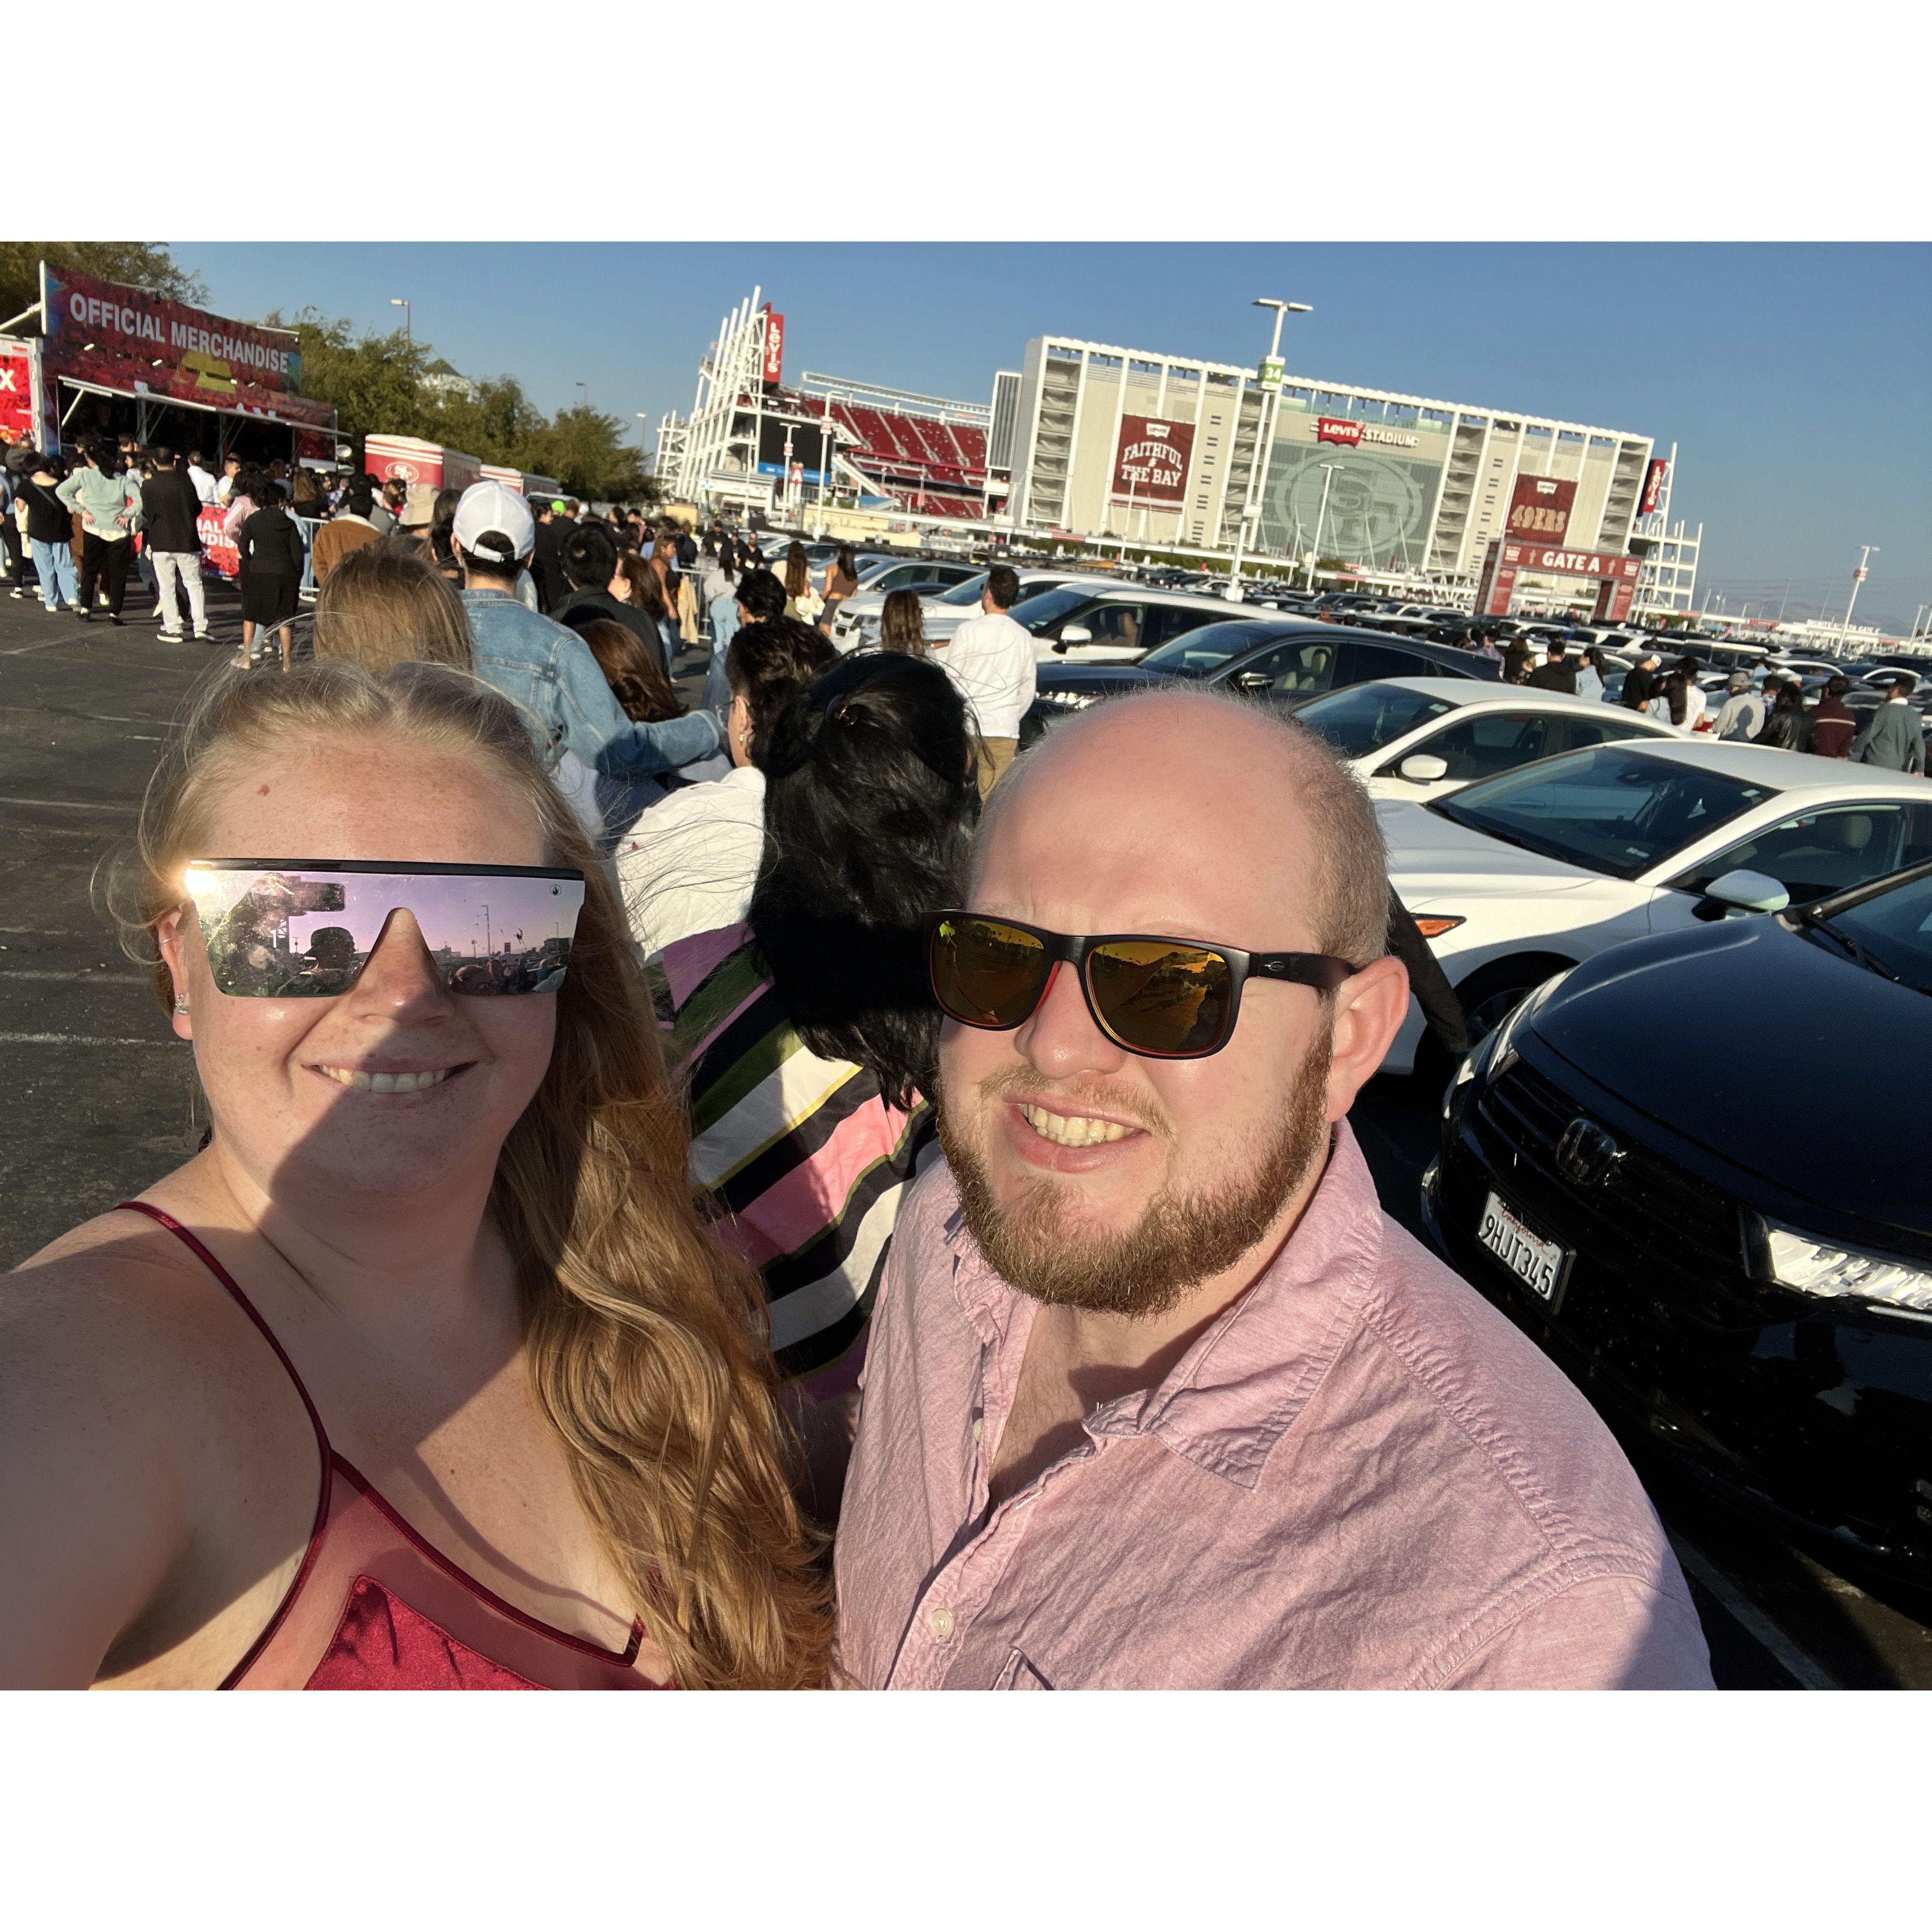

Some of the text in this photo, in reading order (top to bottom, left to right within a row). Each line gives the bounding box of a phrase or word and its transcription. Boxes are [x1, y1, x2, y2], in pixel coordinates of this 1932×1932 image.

[70, 293, 288, 373] OFFICIAL MERCHANDISE
[1265, 367, 1281, 380] 34
[1364, 429, 1414, 446] STADIUM
[1122, 441, 1183, 471] FAITHFUL
[1121, 464, 1182, 487] THE BAY
[1512, 505, 1566, 533] 49ERS
[1541, 551, 1587, 571] GATE
[1587, 557, 1600, 573] A
[1481, 1214, 1553, 1295] 9HJT345
